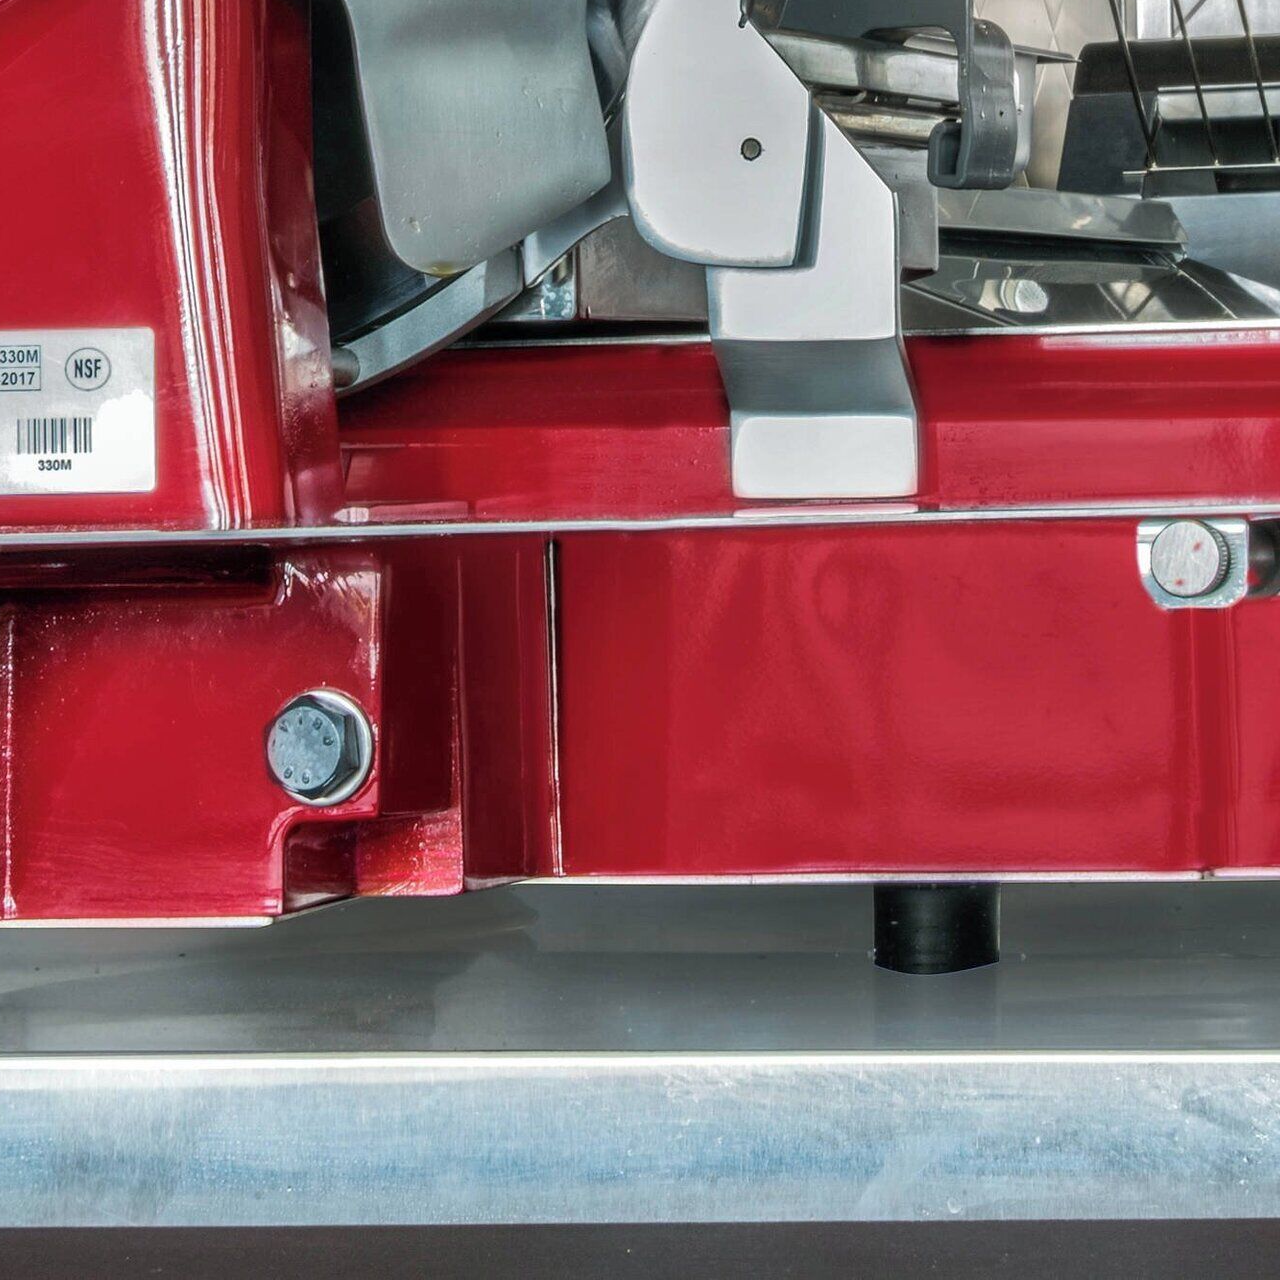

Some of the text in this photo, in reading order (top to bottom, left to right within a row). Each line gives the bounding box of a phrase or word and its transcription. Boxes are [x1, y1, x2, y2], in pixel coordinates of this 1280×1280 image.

[0, 349, 39, 364] 330M
[74, 358, 102, 379] NSF
[38, 459, 72, 471] 330M
